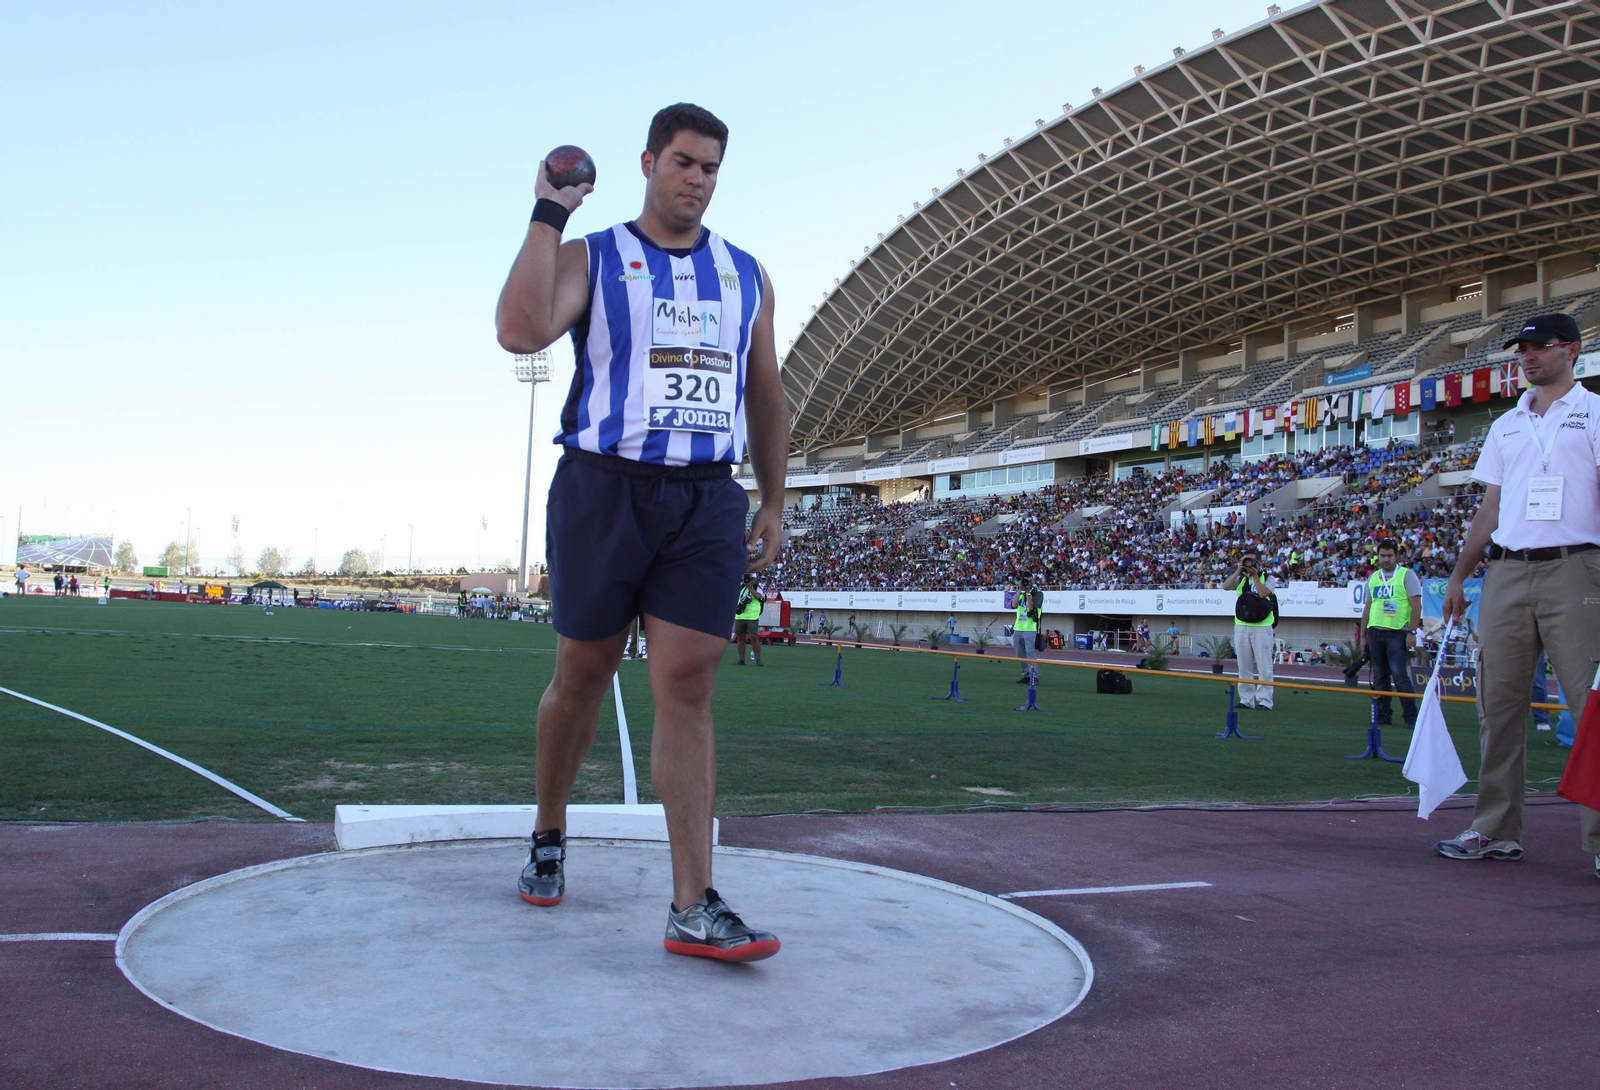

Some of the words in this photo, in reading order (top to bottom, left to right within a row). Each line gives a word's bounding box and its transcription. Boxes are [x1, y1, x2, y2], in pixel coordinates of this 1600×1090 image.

[674, 272, 695, 281] vive
[656, 301, 718, 338] Málaga
[651, 352, 683, 364] Divina
[700, 354, 730, 369] Pastora
[664, 373, 720, 404] 320
